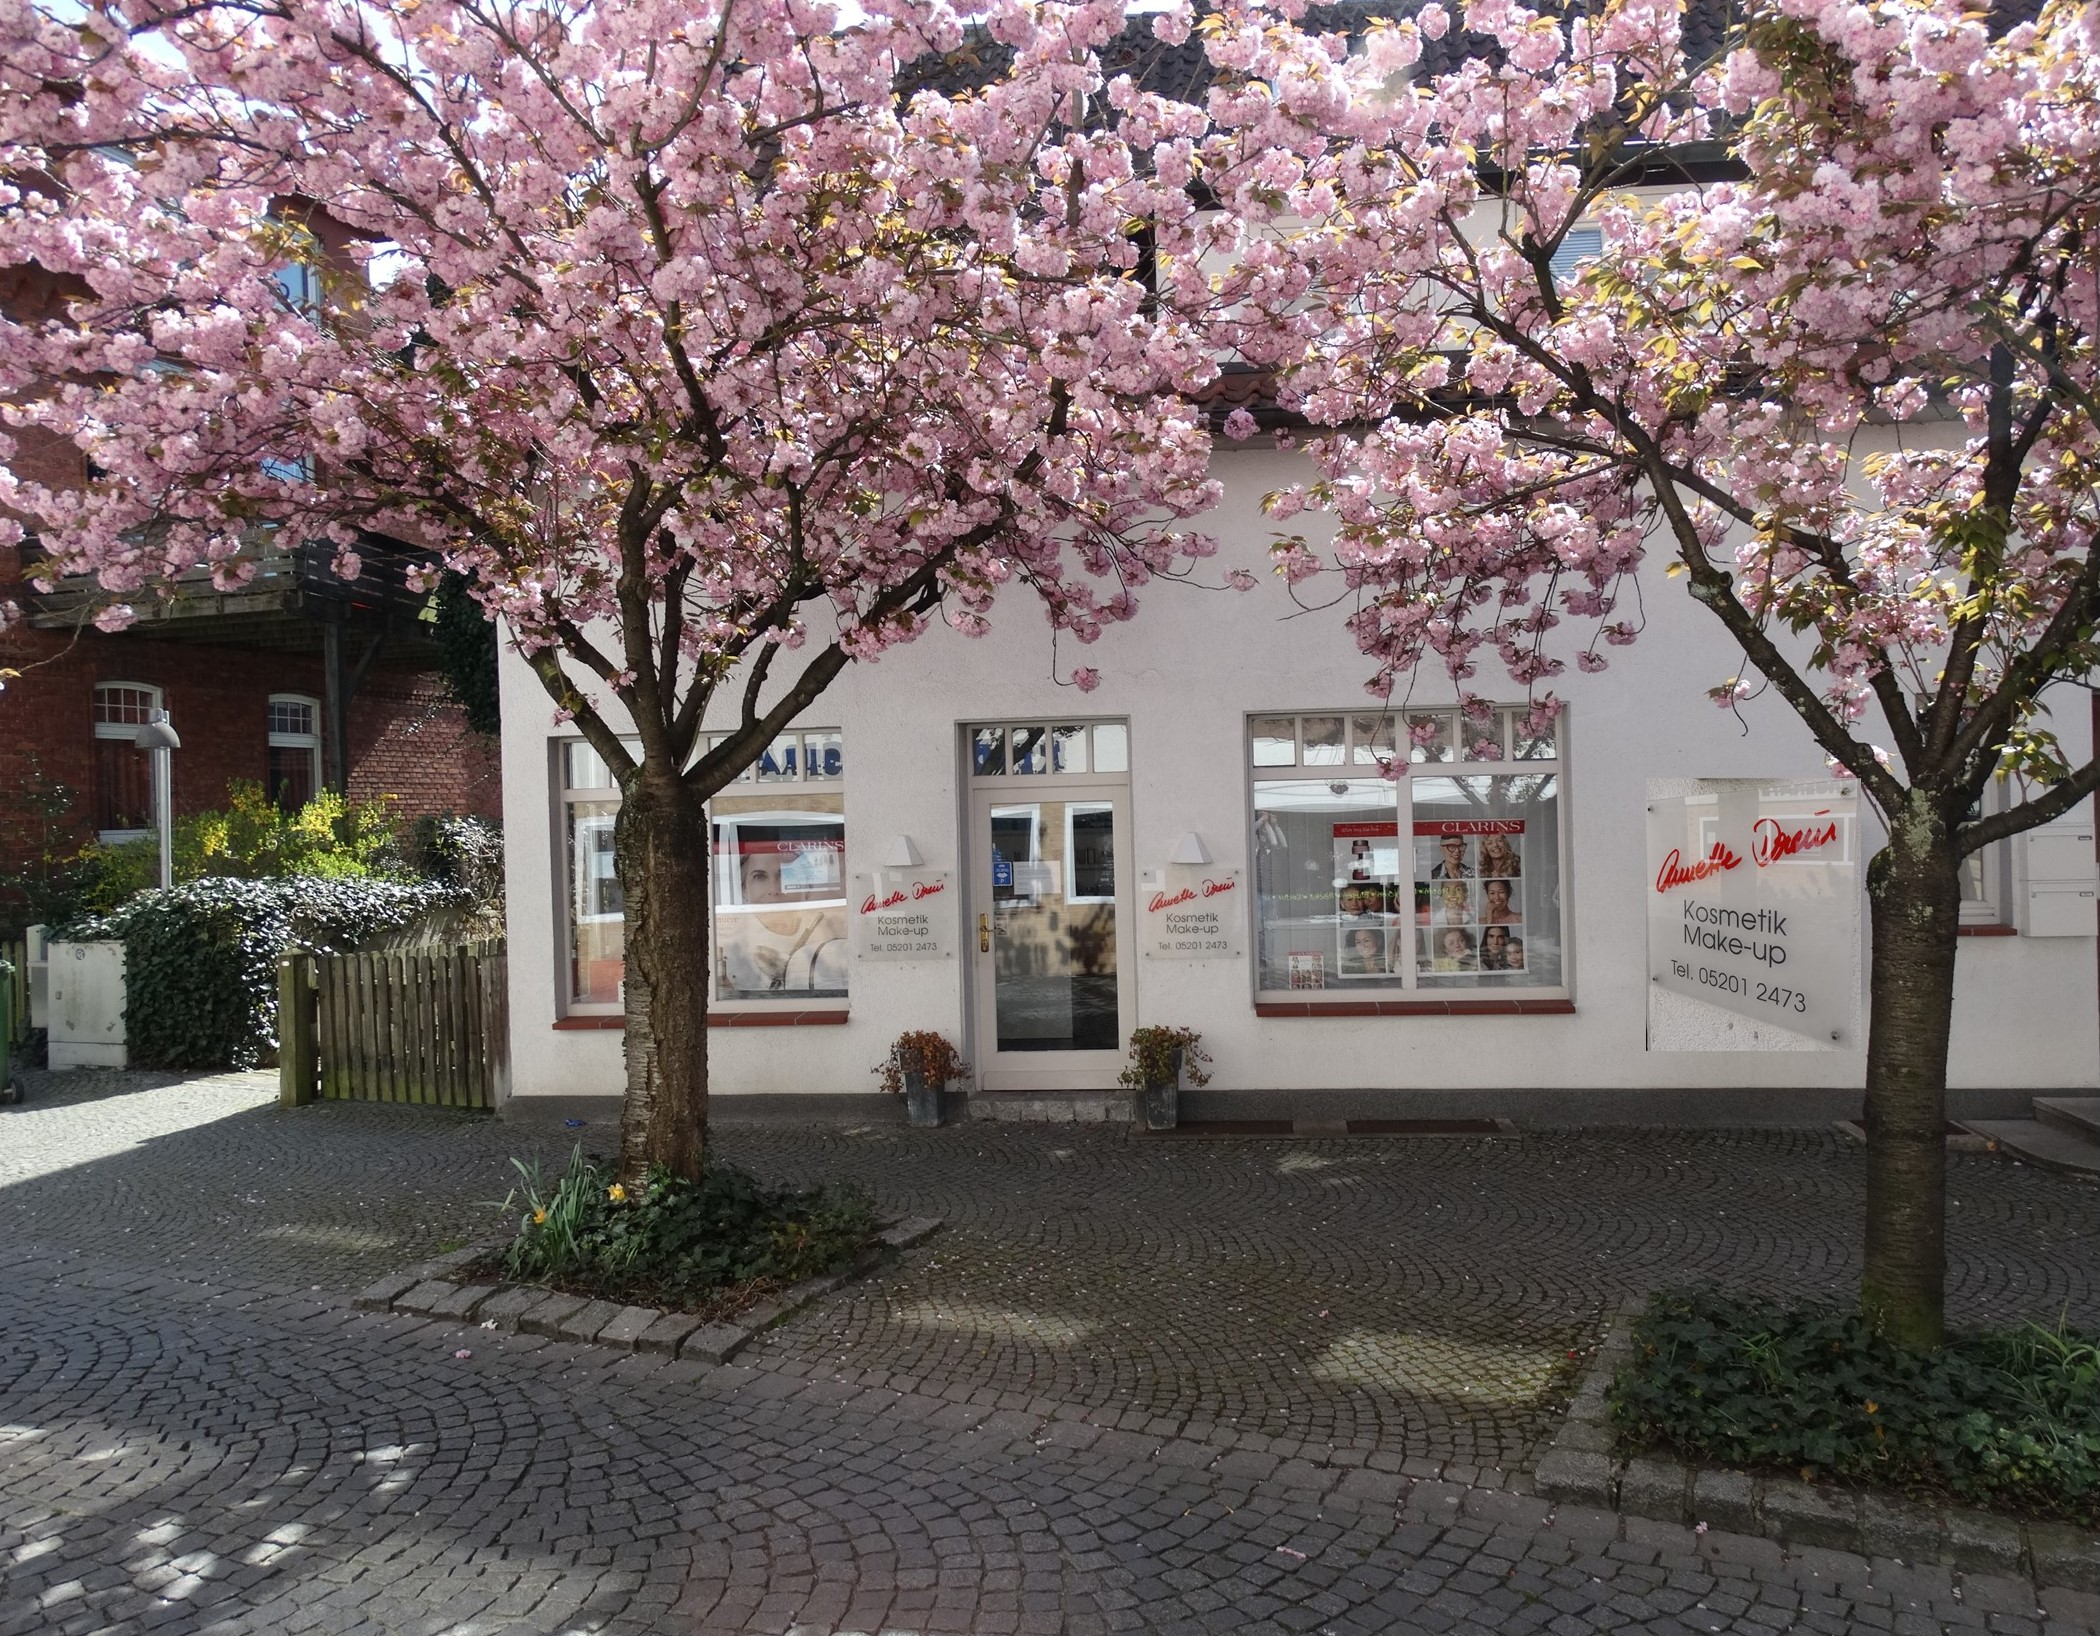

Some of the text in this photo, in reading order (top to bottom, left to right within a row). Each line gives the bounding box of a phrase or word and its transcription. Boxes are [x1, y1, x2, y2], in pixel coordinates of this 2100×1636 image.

[1441, 820, 1521, 833] CLARINS
[777, 840, 844, 851] CLARINS
[1656, 841, 1742, 893] Annette
[877, 914, 929, 925] Kosmetik
[1166, 912, 1219, 923] Kosmetik
[1683, 899, 1788, 937] Kosmetik
[877, 926, 929, 937] Make-up
[1166, 924, 1219, 935] Make-up
[870, 942, 938, 952] Tel. 05201 2473
[1158, 940, 1228, 950] Tel. 05201 2473
[1683, 923, 1787, 968] Make-up
[1670, 959, 1807, 1013] Tel. 05201 2473
